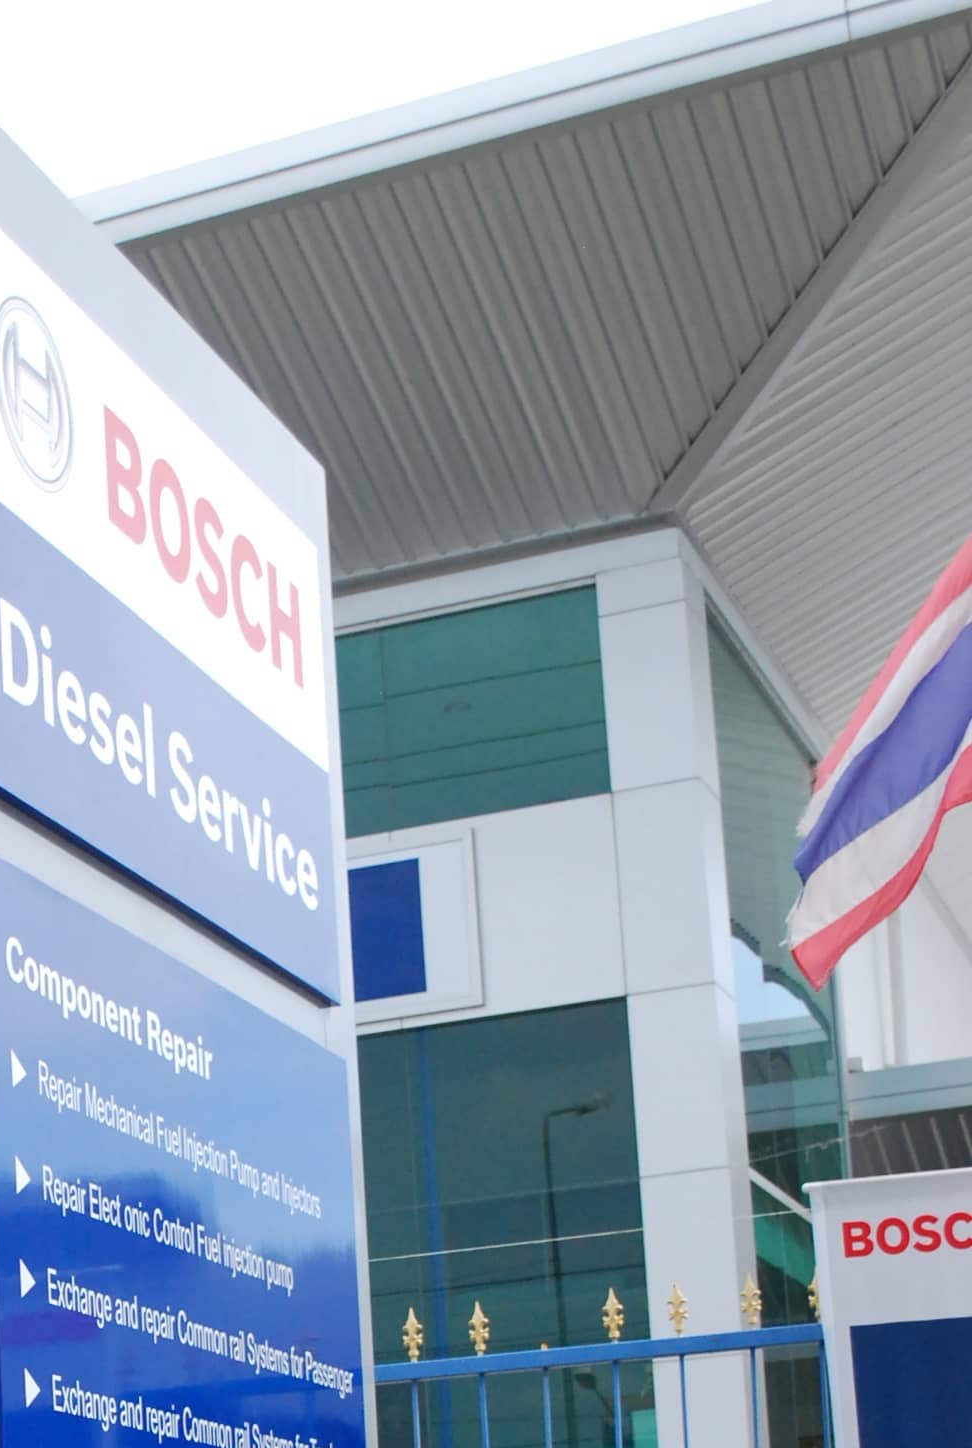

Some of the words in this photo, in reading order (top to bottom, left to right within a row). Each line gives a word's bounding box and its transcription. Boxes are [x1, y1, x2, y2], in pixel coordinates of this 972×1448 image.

[103, 404, 304, 688] BOSCH
[0, 598, 156, 797] Diesel
[169, 731, 319, 910] Service
[6, 936, 142, 1046] Component
[146, 1009, 213, 1080] Repair
[38, 1059, 82, 1113] Repair
[85, 1081, 154, 1144] Mechanical
[156, 1115, 181, 1158] Fuel
[183, 1127, 227, 1173] Injection
[230, 1149, 260, 1198] Pump
[261, 1171, 280, 1201] and
[281, 1173, 321, 1219] Injectors
[42, 1165, 86, 1217] Repair
[153, 1207, 195, 1255] Control
[197, 1223, 221, 1264] Fuel
[222, 1234, 264, 1280] injection
[266, 1259, 294, 1297] pump
[842, 1211, 972, 1258] BOSC
[47, 1267, 112, 1329] Exchange
[115, 1295, 138, 1330] and
[141, 1305, 175, 1344] repair
[178, 1310, 228, 1357] Common
[229, 1330, 245, 1363] rail
[247, 1332, 289, 1375] Systems
[290, 1345, 303, 1379] for
[305, 1351, 354, 1399] Passenger
[52, 1374, 117, 1432] Exchange
[120, 1396, 143, 1431] and
[146, 1404, 180, 1445] repair
